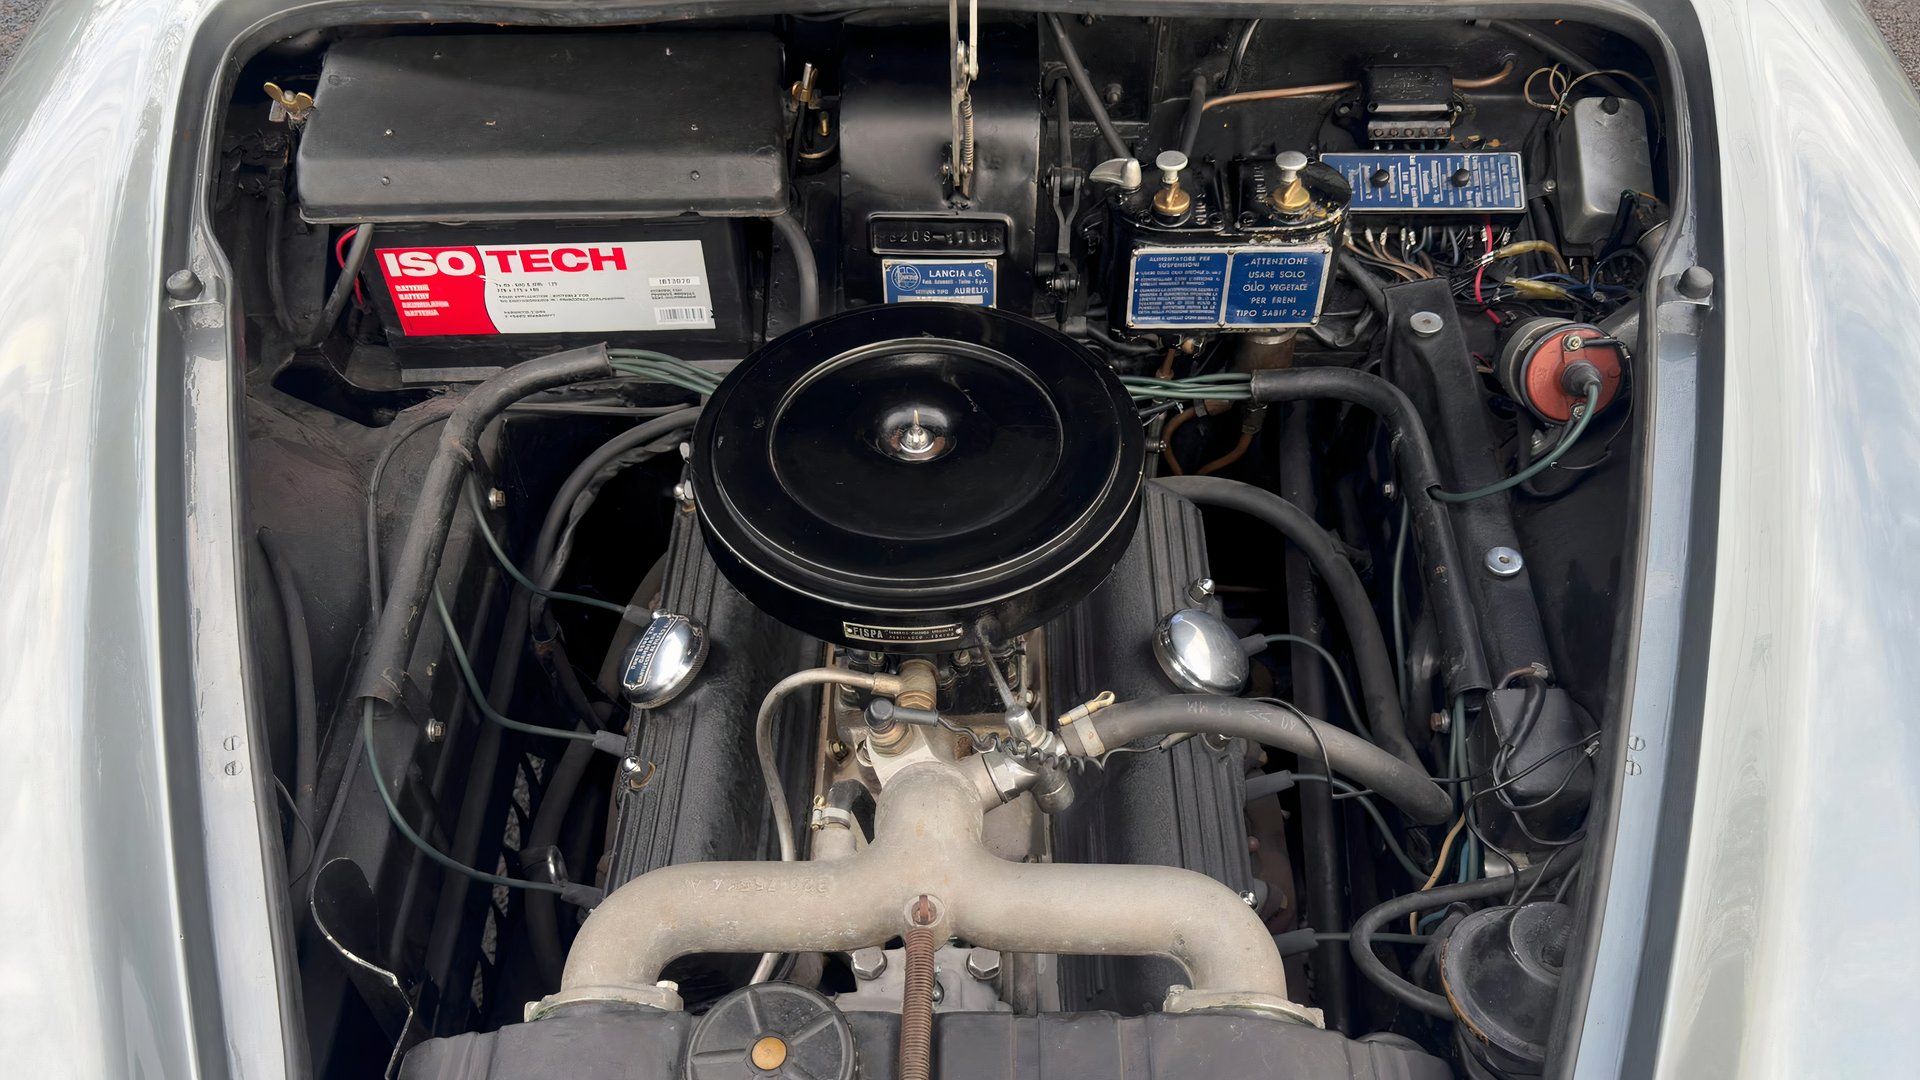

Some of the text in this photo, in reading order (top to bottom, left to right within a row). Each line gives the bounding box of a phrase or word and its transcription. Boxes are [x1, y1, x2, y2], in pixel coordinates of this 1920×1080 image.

[383, 247, 627, 277] ISO TECH
[1251, 257, 1308, 265] ATTENZIONE
[1243, 283, 1308, 291] OLIO VEGETALE
[1271, 296, 1296, 304] FRENI
[852, 626, 884, 639] FISPA
